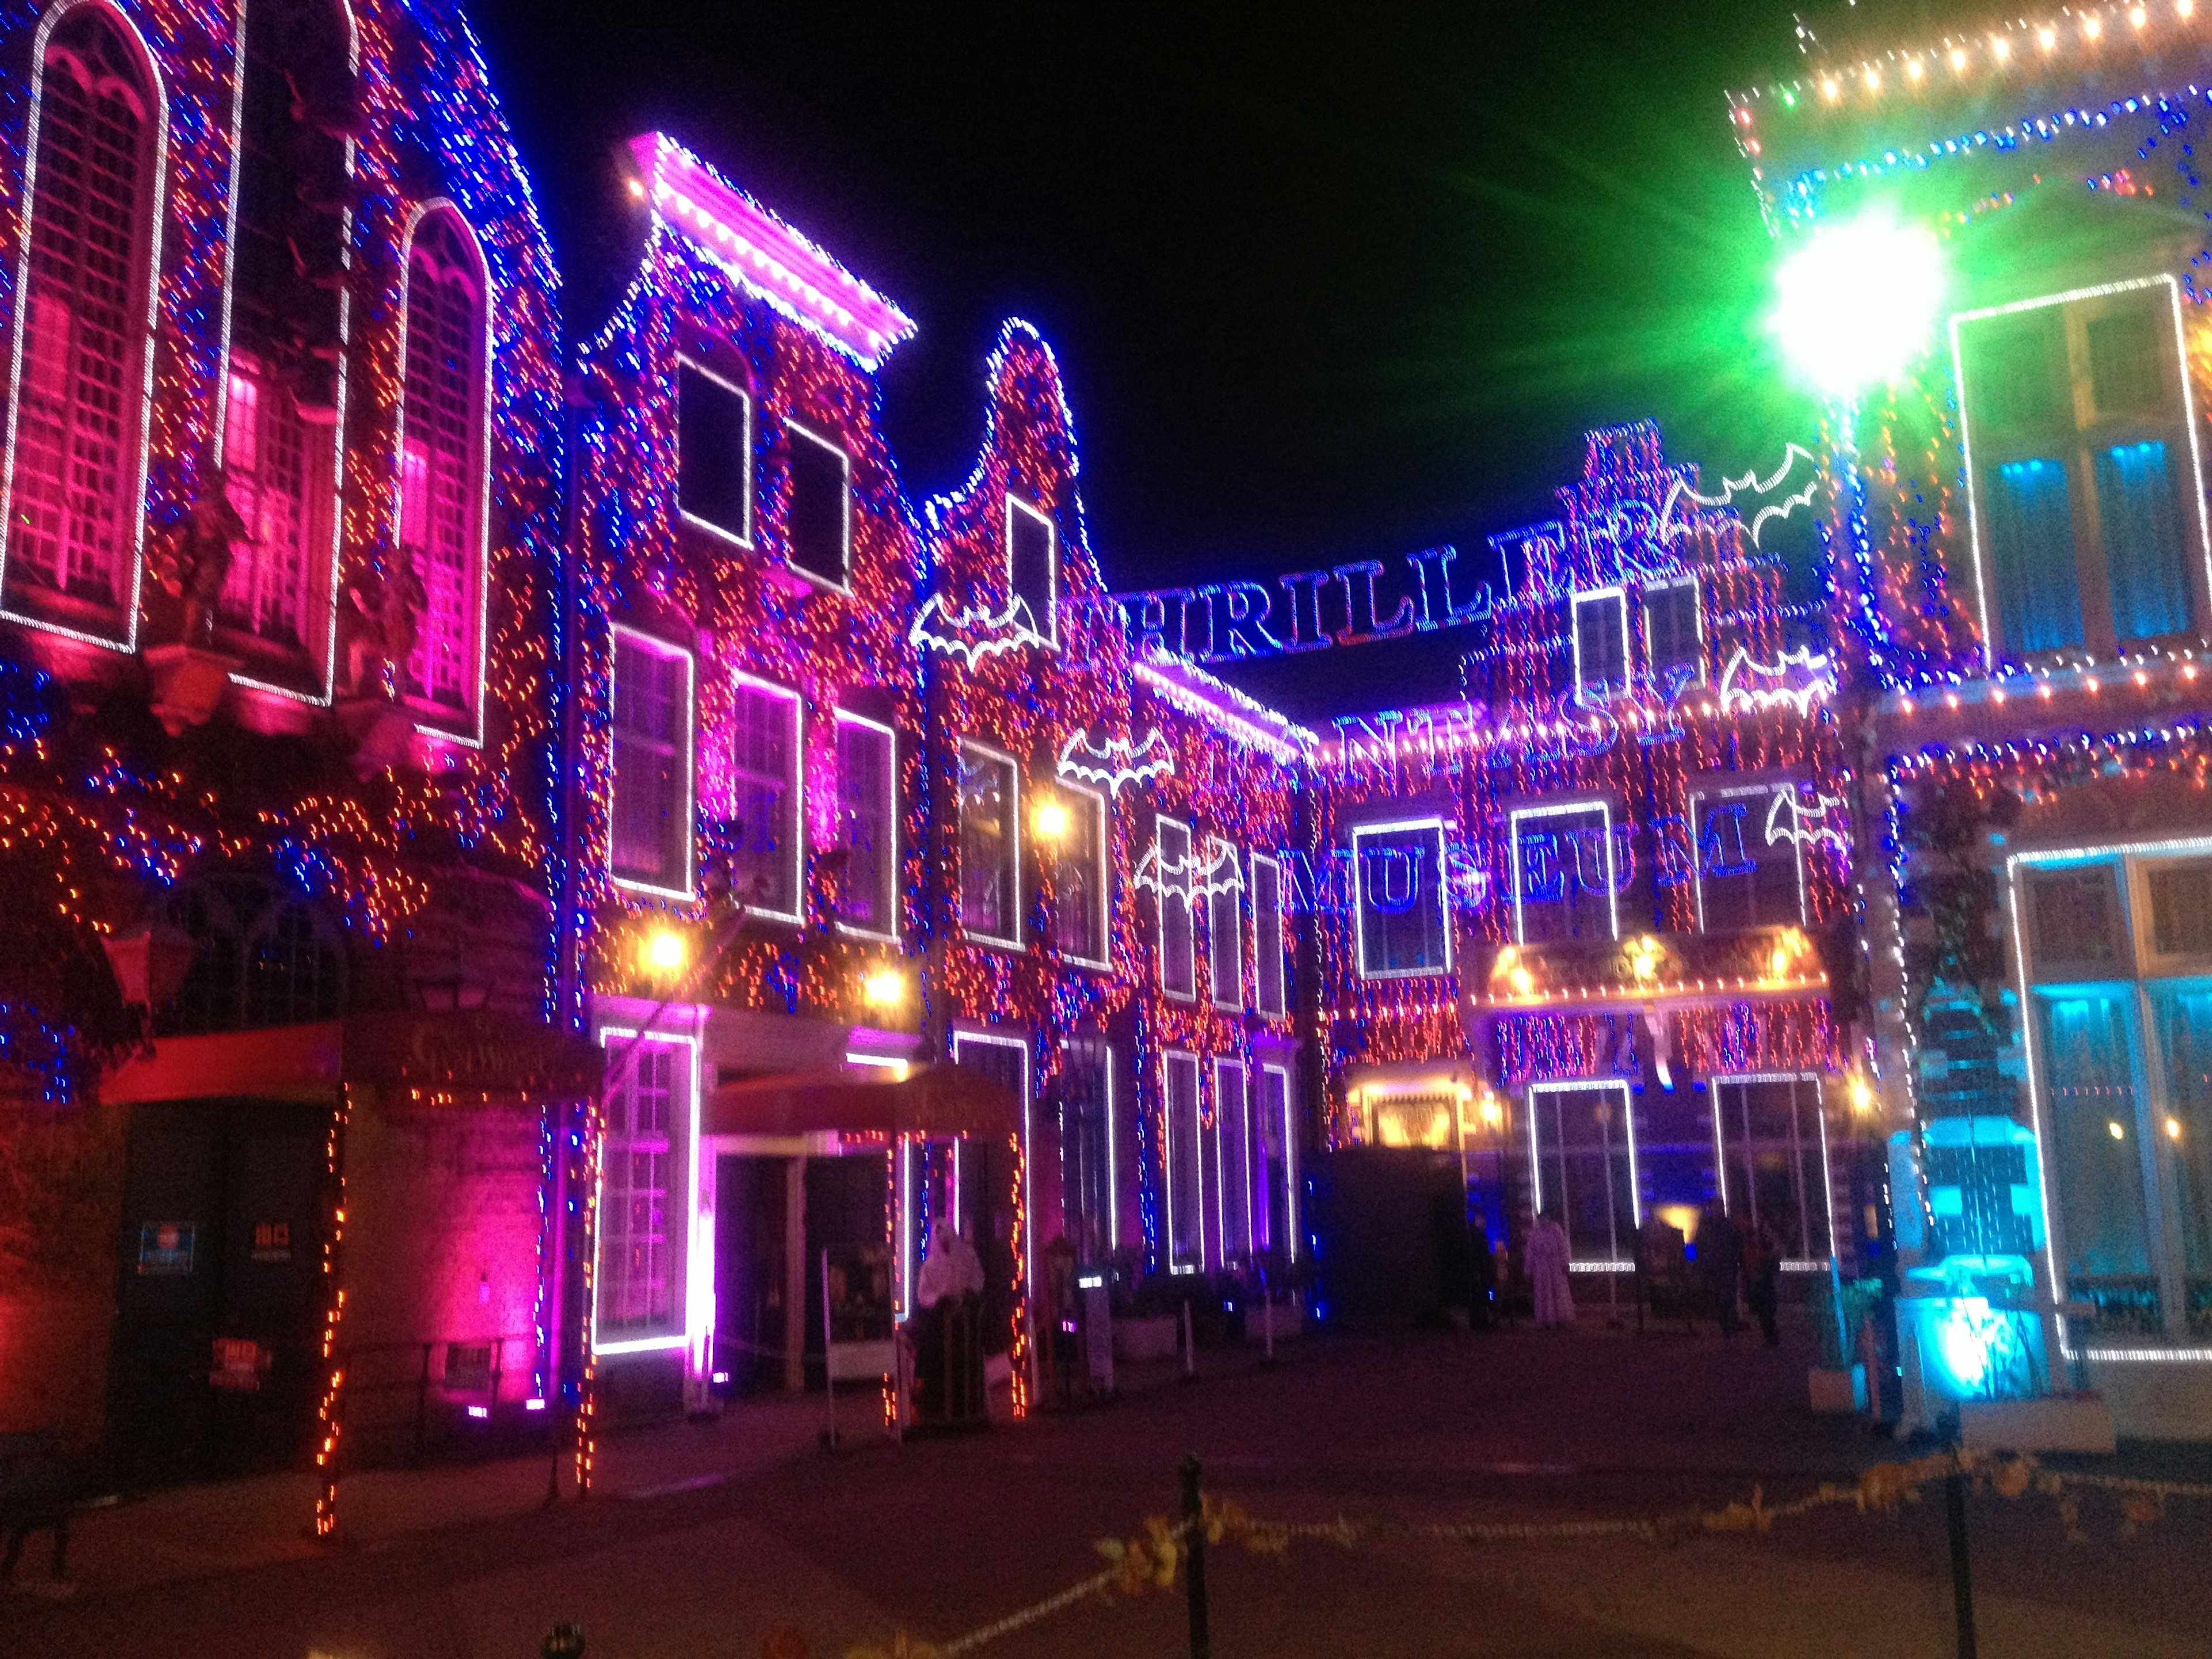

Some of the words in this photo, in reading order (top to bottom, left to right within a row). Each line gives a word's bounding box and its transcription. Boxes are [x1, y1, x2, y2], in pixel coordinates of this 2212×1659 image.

[1047, 499, 1679, 672] THRILLER
[1200, 662, 1695, 794] FANTASY
[1274, 802, 1758, 915] MUSEUM
